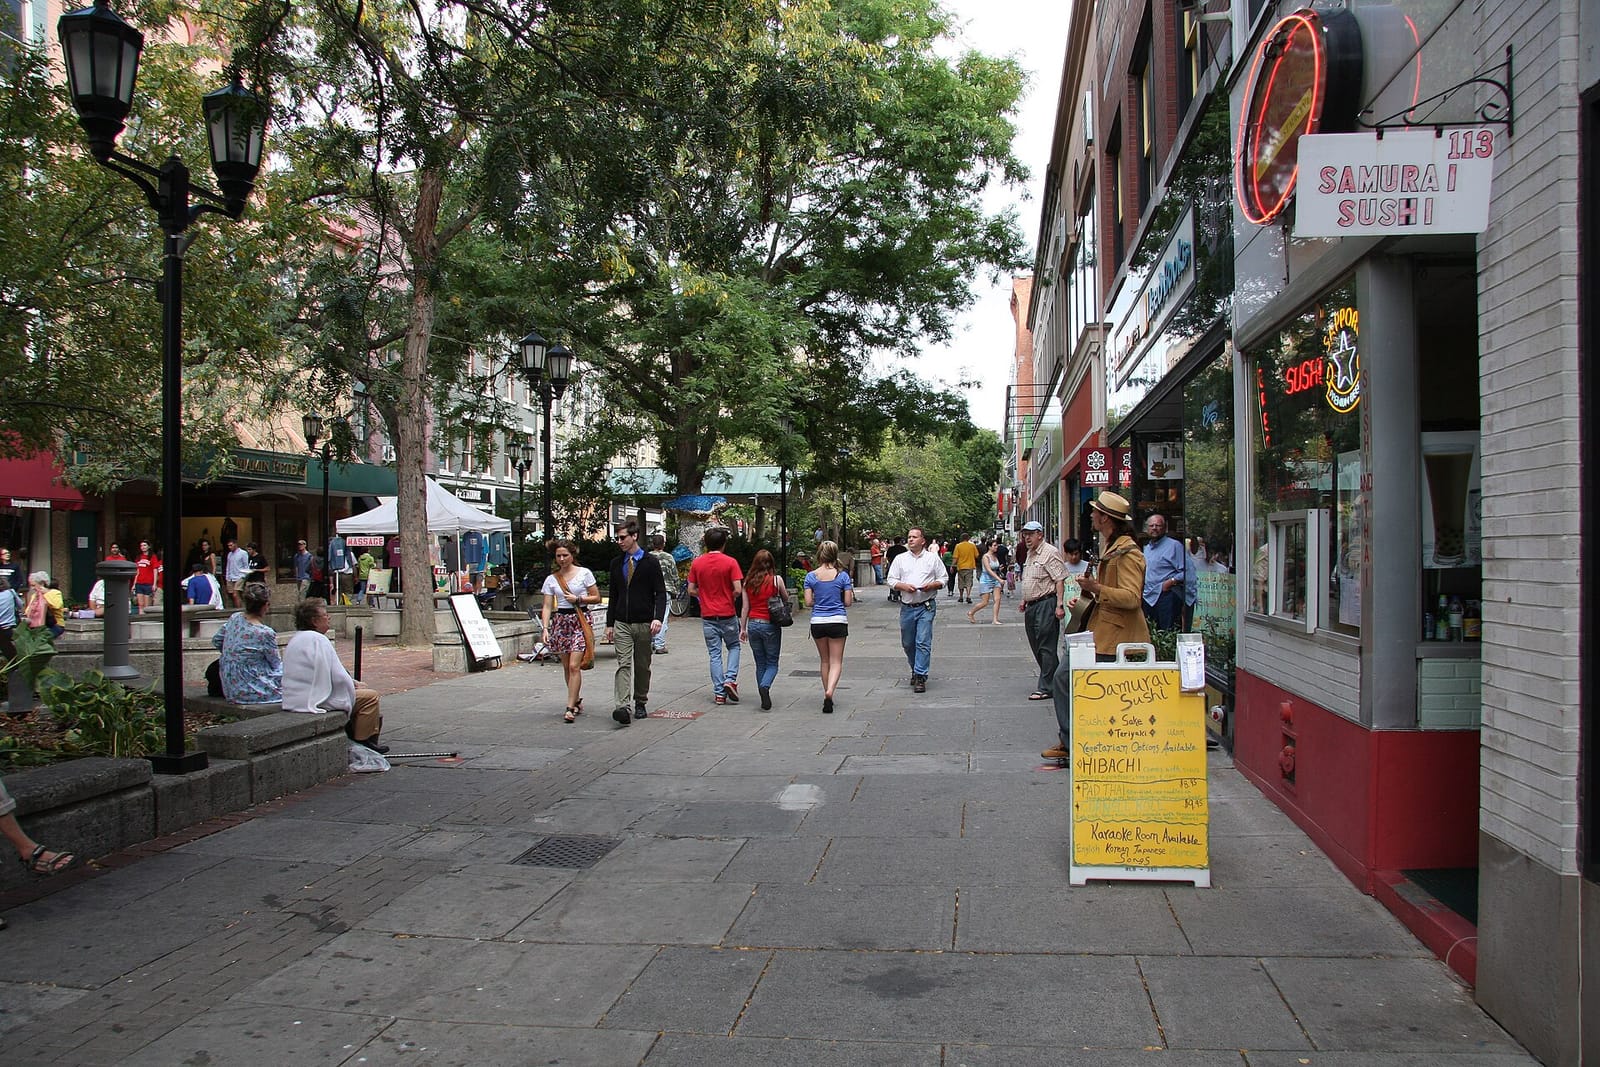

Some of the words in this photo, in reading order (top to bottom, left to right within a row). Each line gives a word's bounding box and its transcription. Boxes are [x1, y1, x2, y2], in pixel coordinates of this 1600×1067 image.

[1448, 130, 1494, 159] 113
[1319, 163, 1457, 194] SAMURAI
[1337, 198, 1434, 227] SUSHI
[1323, 307, 1359, 352] SAPPOR
[1285, 356, 1325, 394] SUSHI
[1362, 369, 1370, 472] SUSHI
[1085, 472, 1109, 482] ATM
[1360, 473, 1373, 493] AND
[347, 537, 384, 546] MASSAGE
[1362, 499, 1370, 588] THAI
[1120, 686, 1169, 711] Sushi
[1121, 713, 1143, 727] Sake
[1114, 728, 1147, 740] Teriyaki
[1078, 741, 1128, 757] Vegetarian
[1130, 741, 1159, 754] Options
[1161, 740, 1197, 754] Available
[1082, 757, 1141, 775] HIBACHI
[1081, 782, 1101, 798] PAD
[1102, 783, 1125, 797] THAI
[1090, 822, 1134, 841] Karaoke
[1135, 827, 1161, 844] Room
[1161, 826, 1203, 845] Available
[1105, 843, 1130, 857] Korean
[1133, 844, 1167, 856] Japanese
[1114, 853, 1150, 866] Songs
